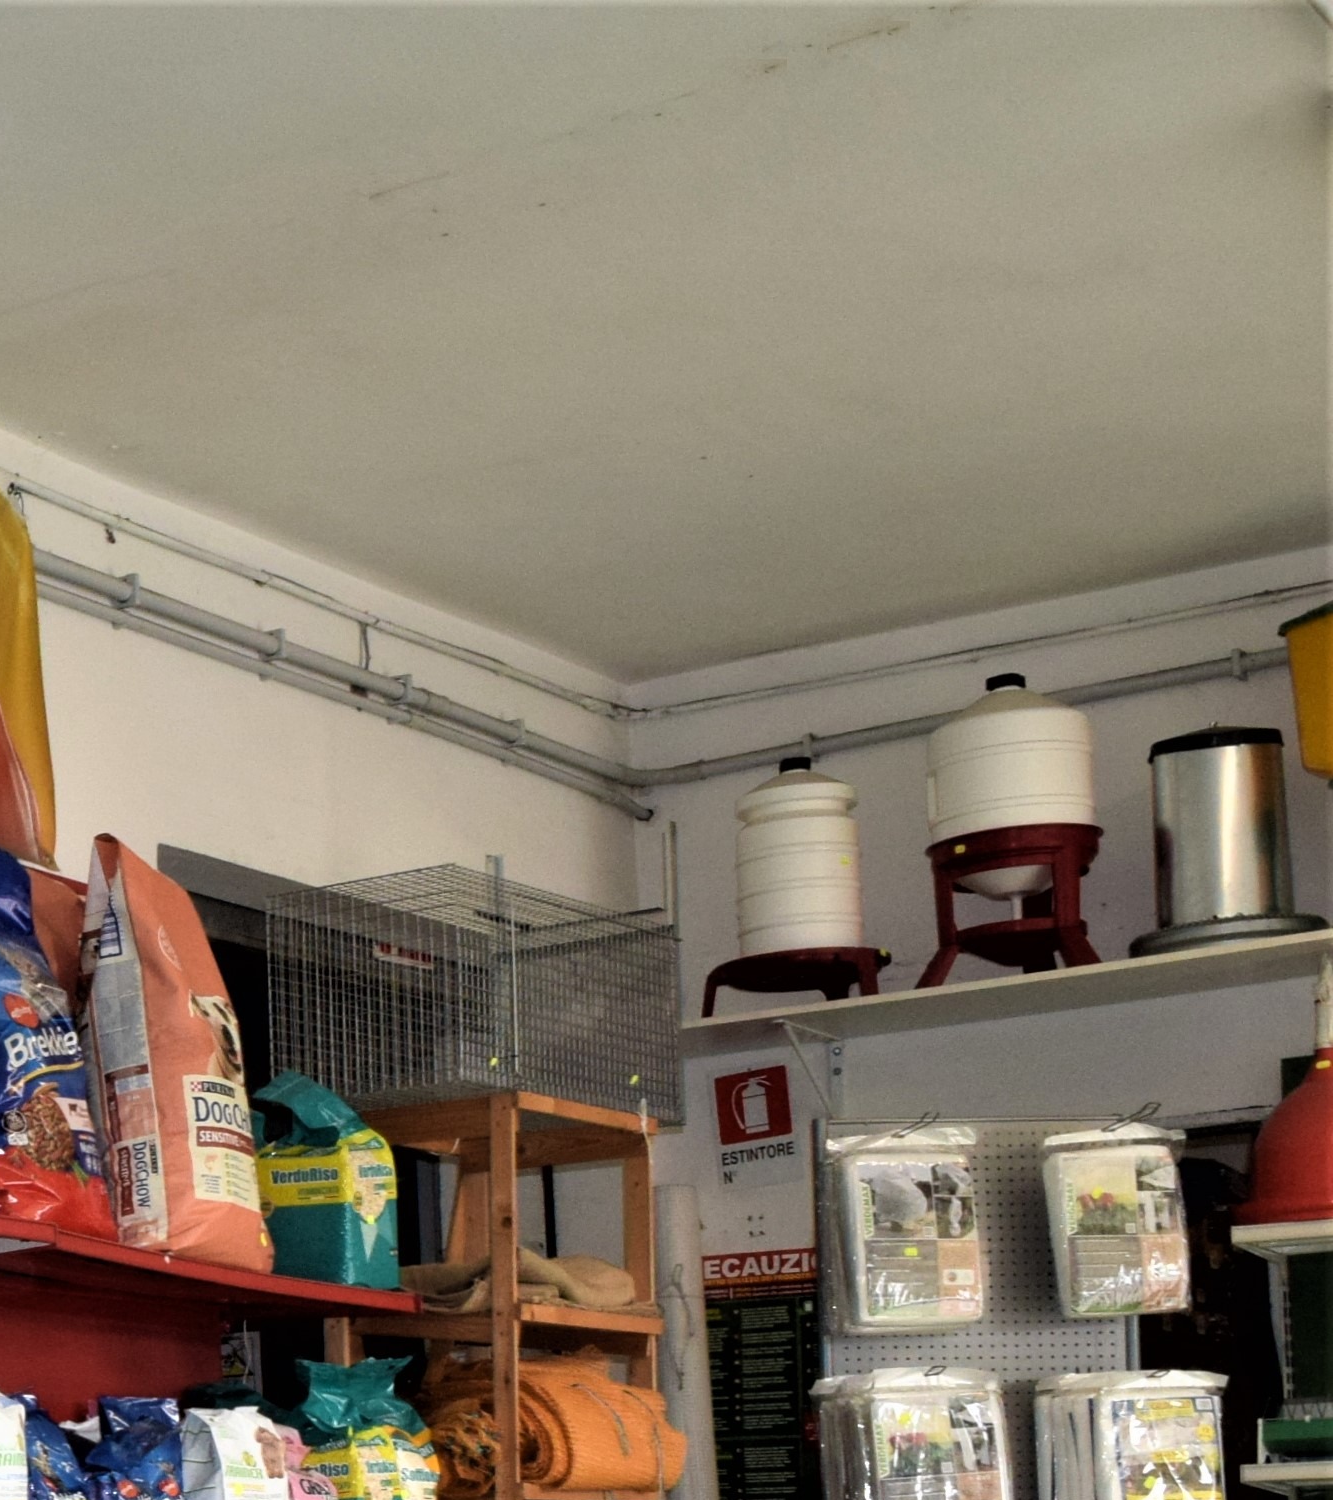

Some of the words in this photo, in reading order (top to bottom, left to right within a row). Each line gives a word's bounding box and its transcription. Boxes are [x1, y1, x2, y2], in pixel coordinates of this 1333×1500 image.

[4, 1028, 81, 1068] Brekkie
[721, 1141, 795, 1167] ESTINTORE
[270, 1166, 339, 1185] VerduRiso
[704, 1252, 817, 1280] ECAUZI
